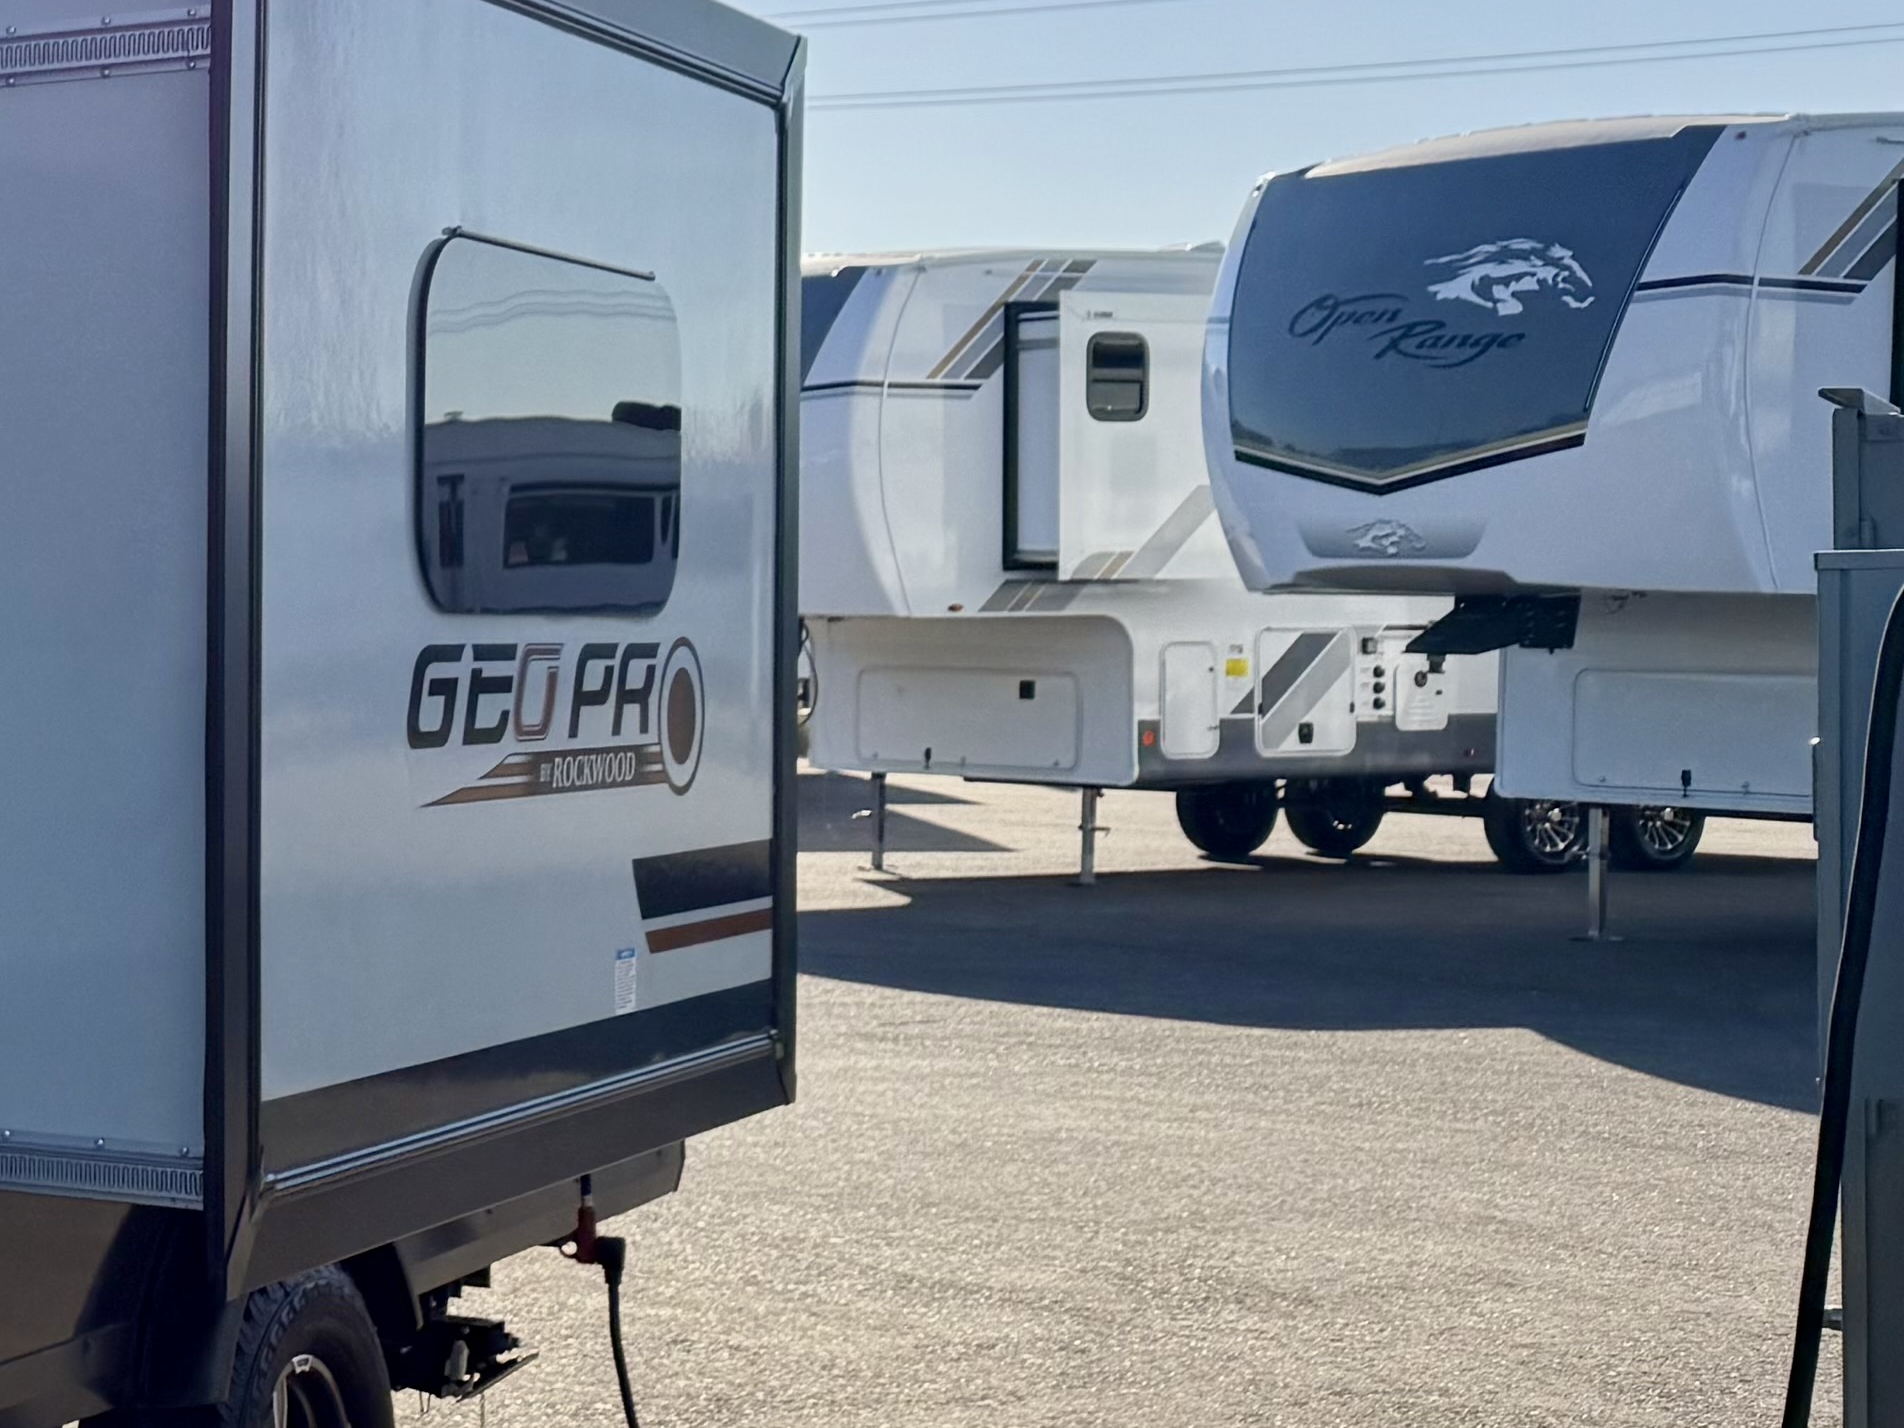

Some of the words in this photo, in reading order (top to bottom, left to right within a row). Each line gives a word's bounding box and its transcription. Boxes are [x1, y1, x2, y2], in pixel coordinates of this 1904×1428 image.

[1288, 292, 1409, 347] Open
[1367, 319, 1527, 369] Range
[406, 642, 565, 750] GEO
[552, 751, 636, 789] ROCKWOOD
